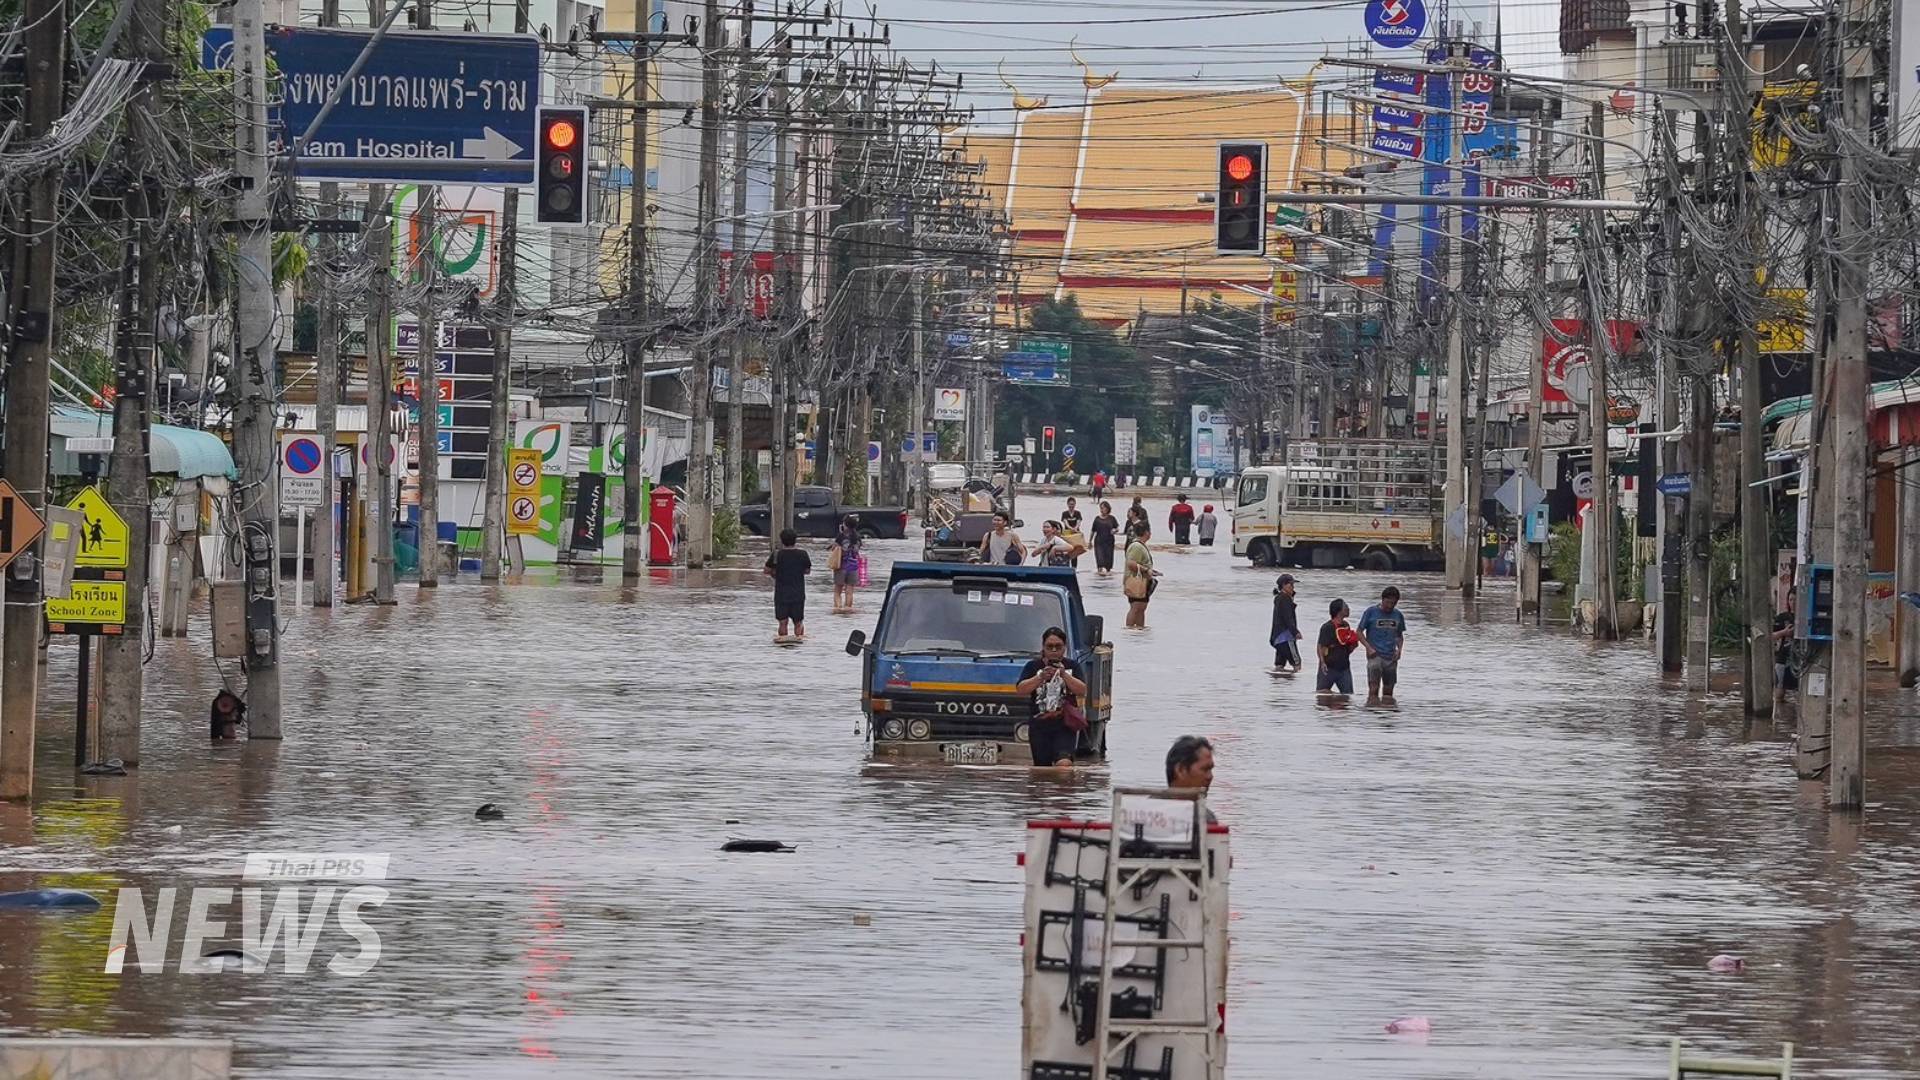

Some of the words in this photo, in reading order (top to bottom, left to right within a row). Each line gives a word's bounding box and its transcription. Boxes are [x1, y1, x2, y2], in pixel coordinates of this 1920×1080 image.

[357, 138, 455, 159] Hospital
[561, 159, 571, 175] 4
[49, 605, 85, 616] School
[91, 606, 118, 617] Zone
[935, 701, 1009, 715] TOYOTA
